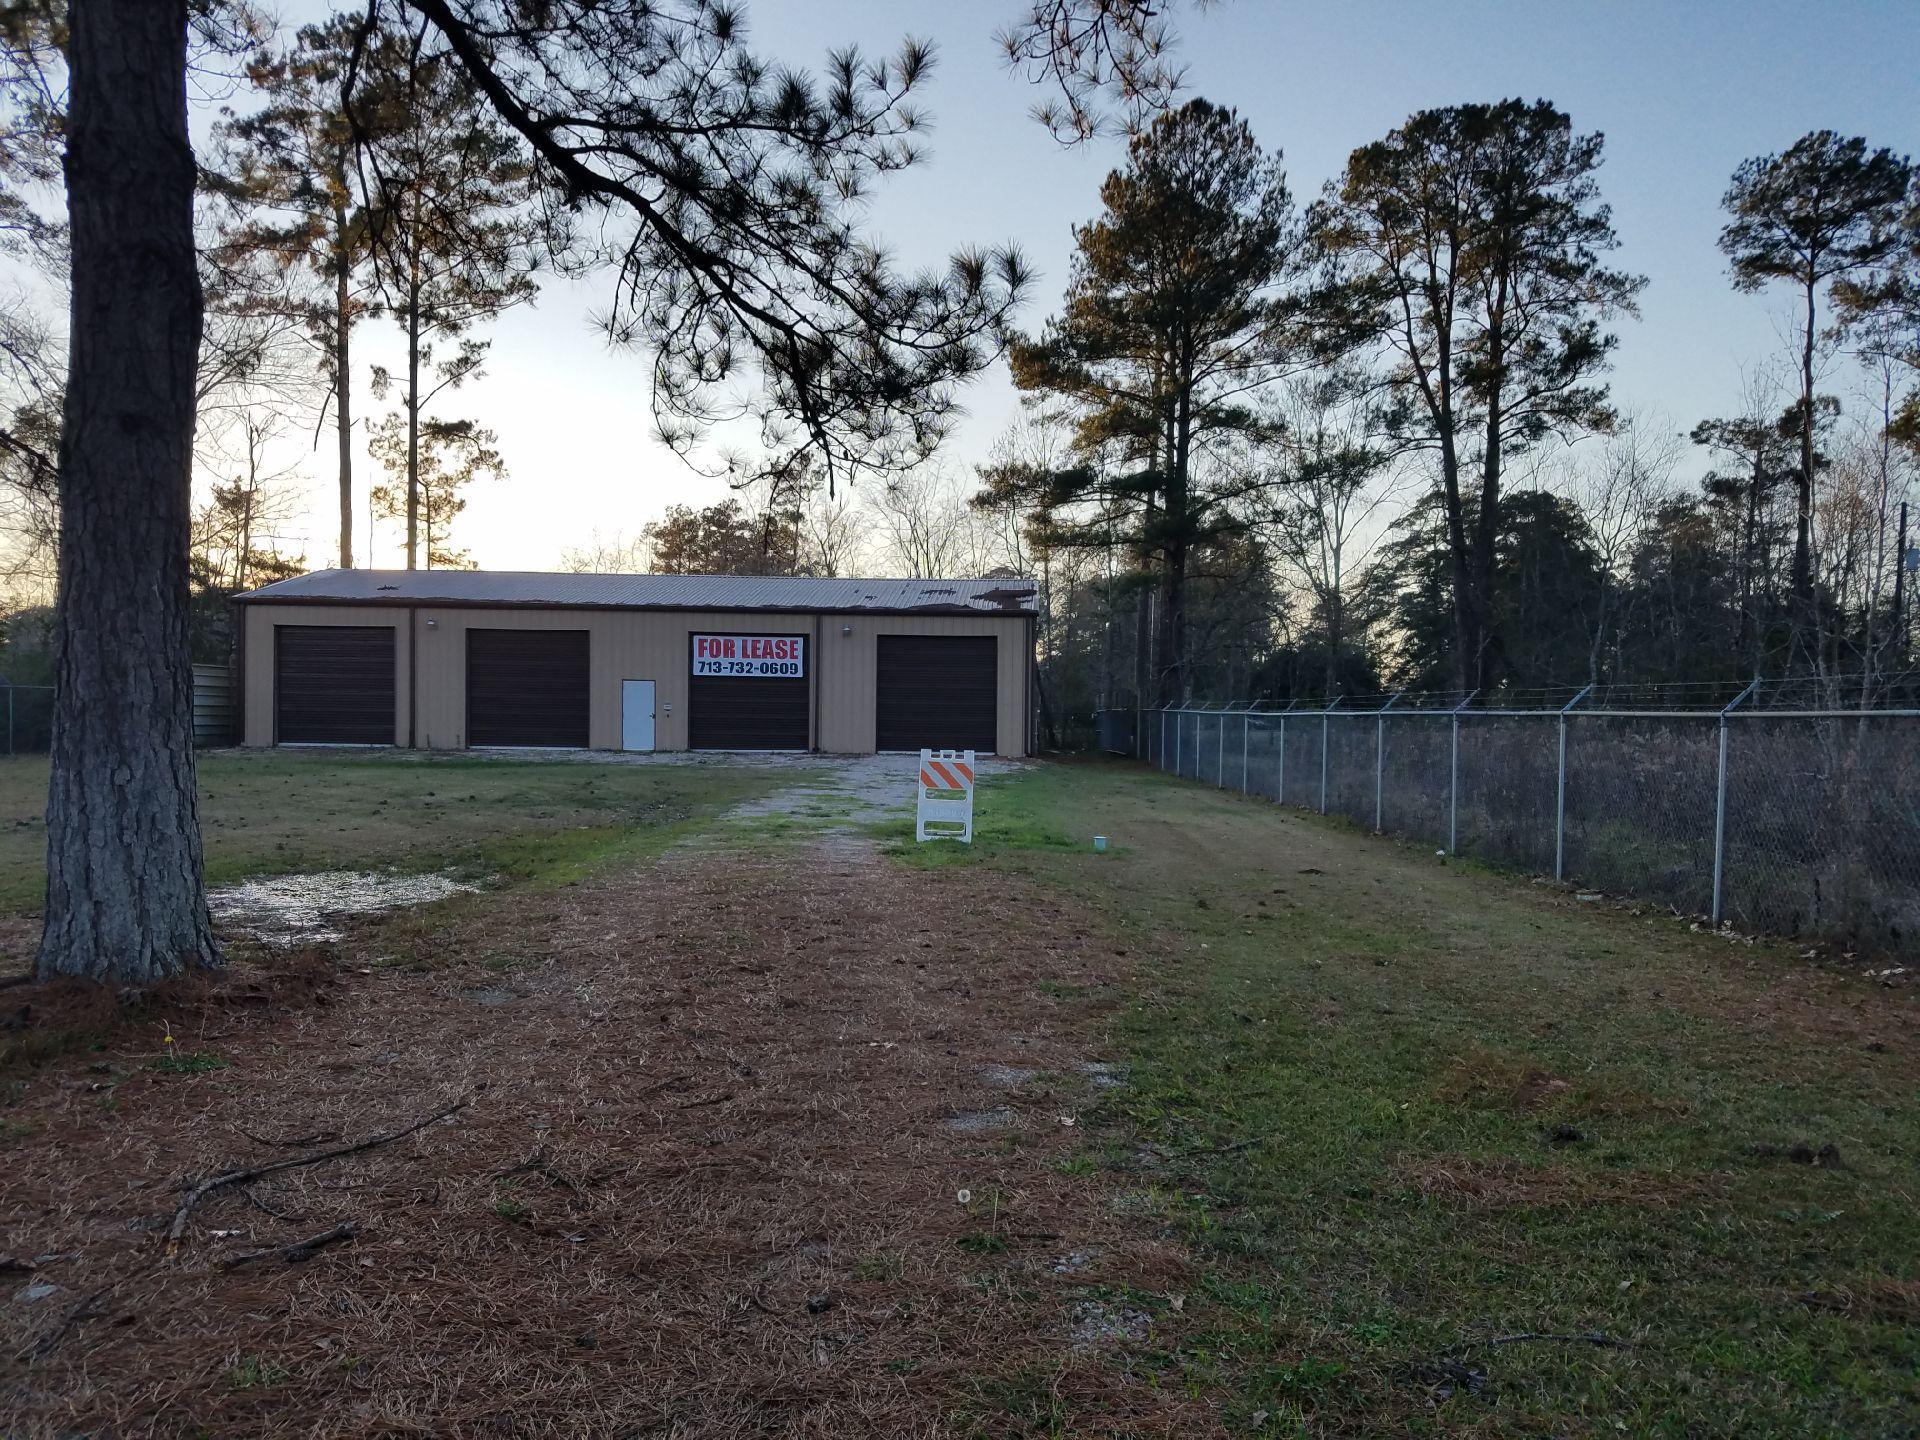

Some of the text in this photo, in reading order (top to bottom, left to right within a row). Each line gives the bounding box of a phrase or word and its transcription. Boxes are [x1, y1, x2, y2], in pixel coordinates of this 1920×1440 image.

[698, 638, 799, 660] FOR LEASE
[698, 661, 799, 675] 713-732-0609
